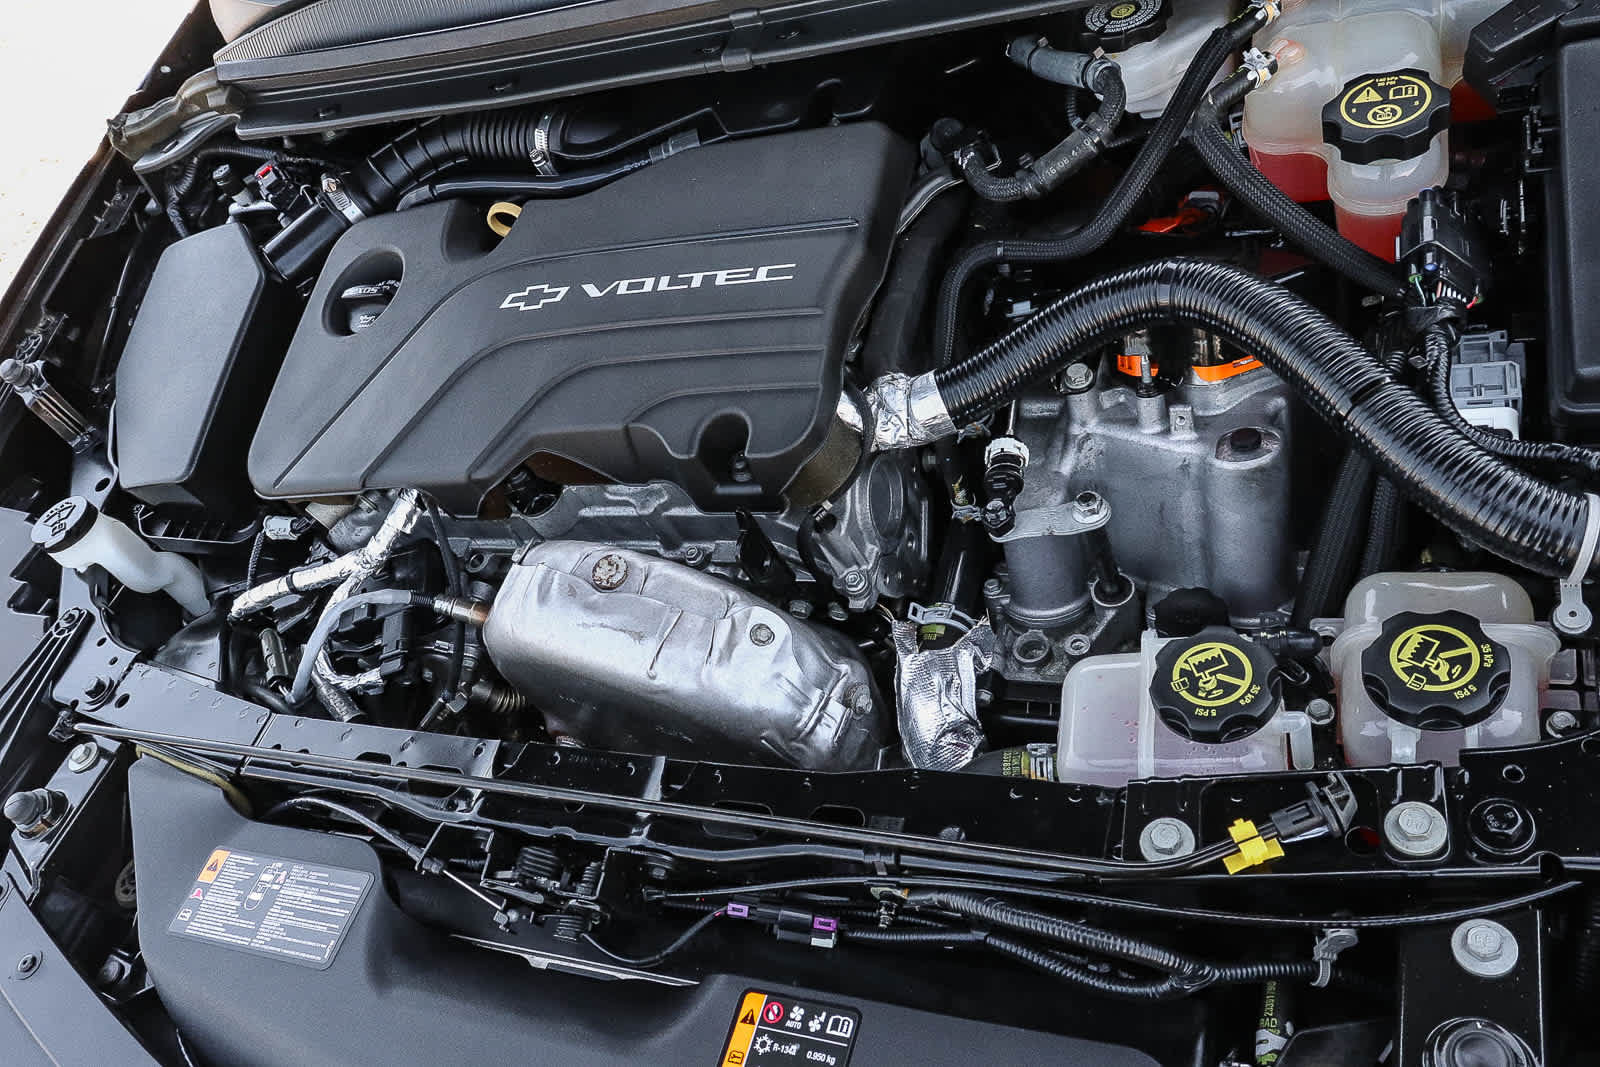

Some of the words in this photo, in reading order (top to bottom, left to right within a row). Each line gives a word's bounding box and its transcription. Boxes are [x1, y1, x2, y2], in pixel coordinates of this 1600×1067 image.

[581, 263, 796, 298] VOLTEC
[1480, 643, 1491, 653] 35
[1483, 654, 1494, 668] kPa
[1250, 684, 1261, 695] 35
[1453, 687, 1471, 700] PSI
[1468, 684, 1478, 693] 5
[1195, 707, 1210, 717] PSI
[1211, 708, 1217, 717] 5
[785, 1019, 802, 1029] AUTO
[806, 1050, 826, 1063] 0.950
[825, 1054, 836, 1066] kg
